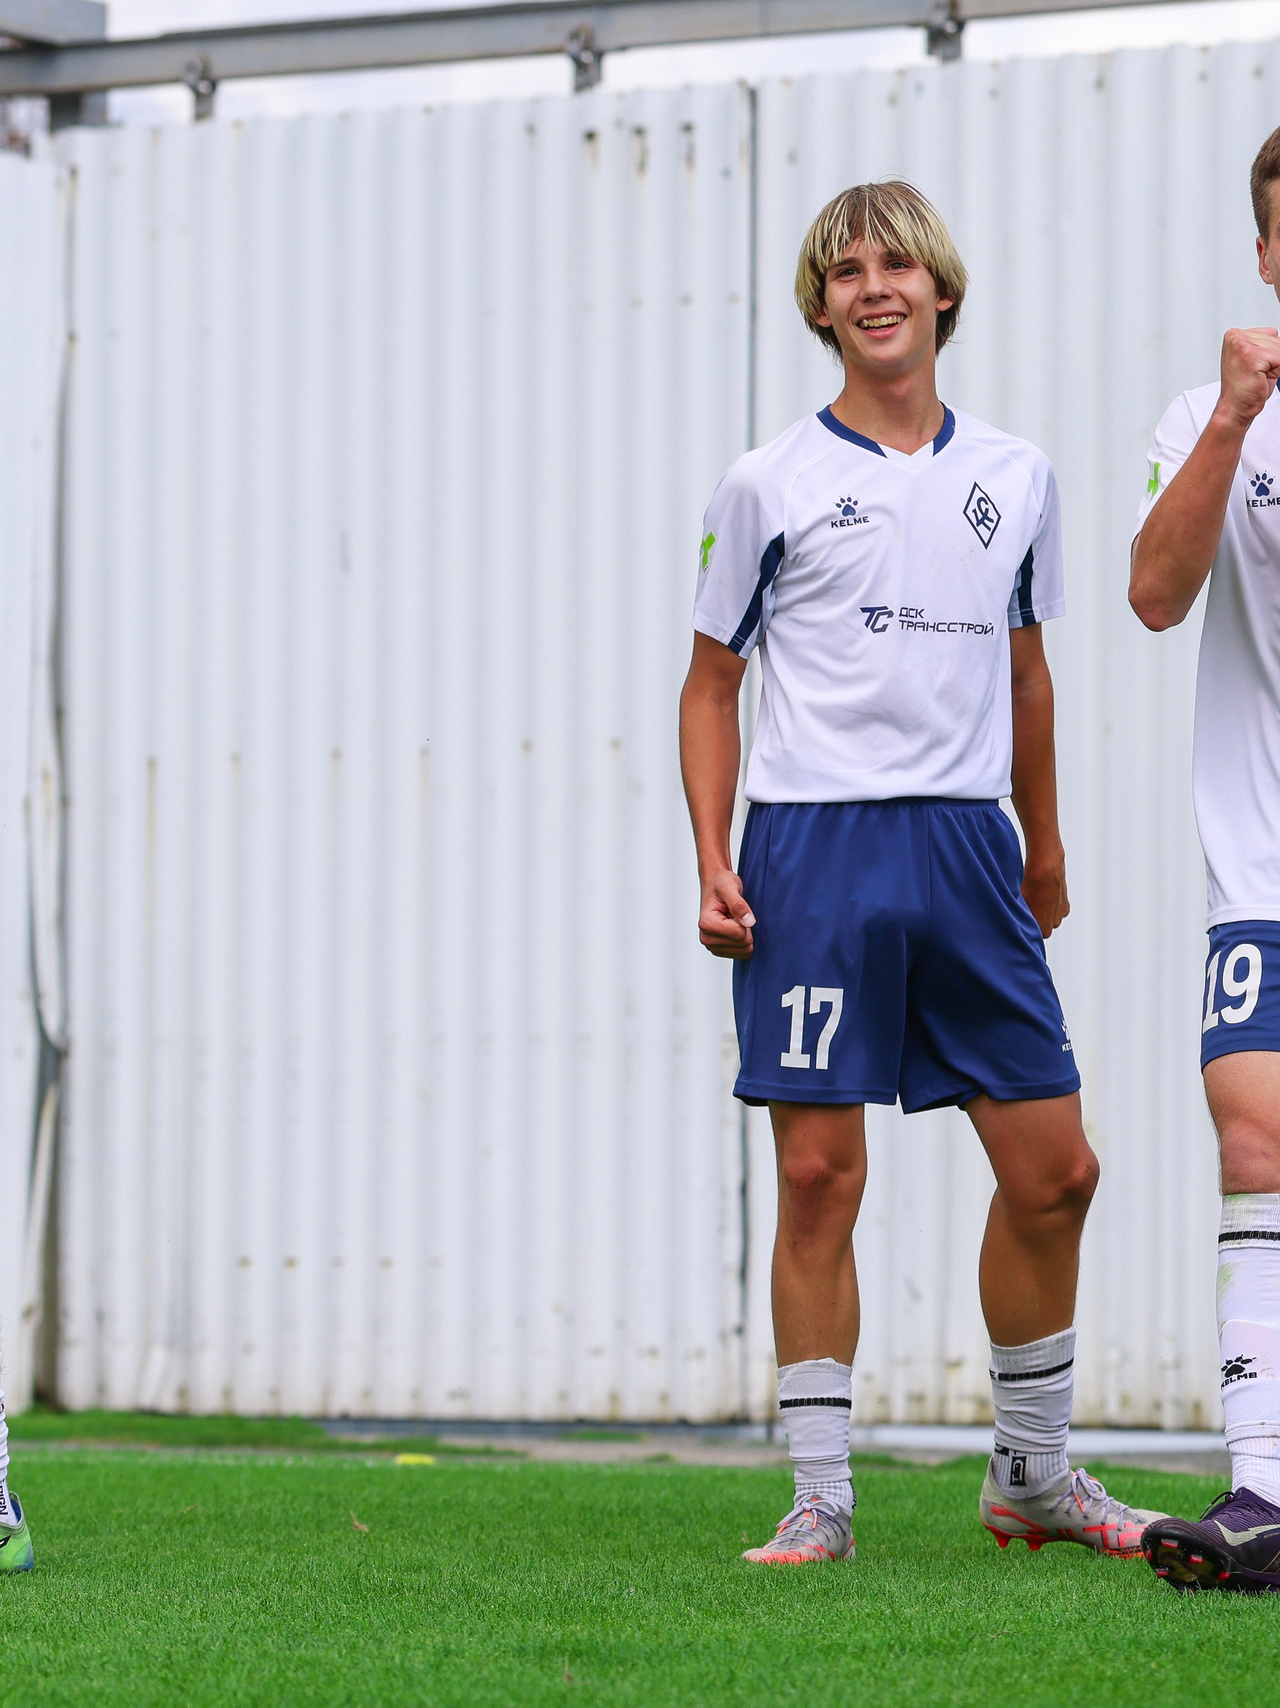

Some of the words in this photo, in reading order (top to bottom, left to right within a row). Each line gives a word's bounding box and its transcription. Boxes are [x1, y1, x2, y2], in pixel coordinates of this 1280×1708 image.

[830, 515, 870, 529] KELME
[898, 606, 925, 619] ДСК
[898, 619, 995, 636] ТРАНССТРОЙ
[1202, 943, 1263, 1034] 19
[780, 985, 844, 1070] 17
